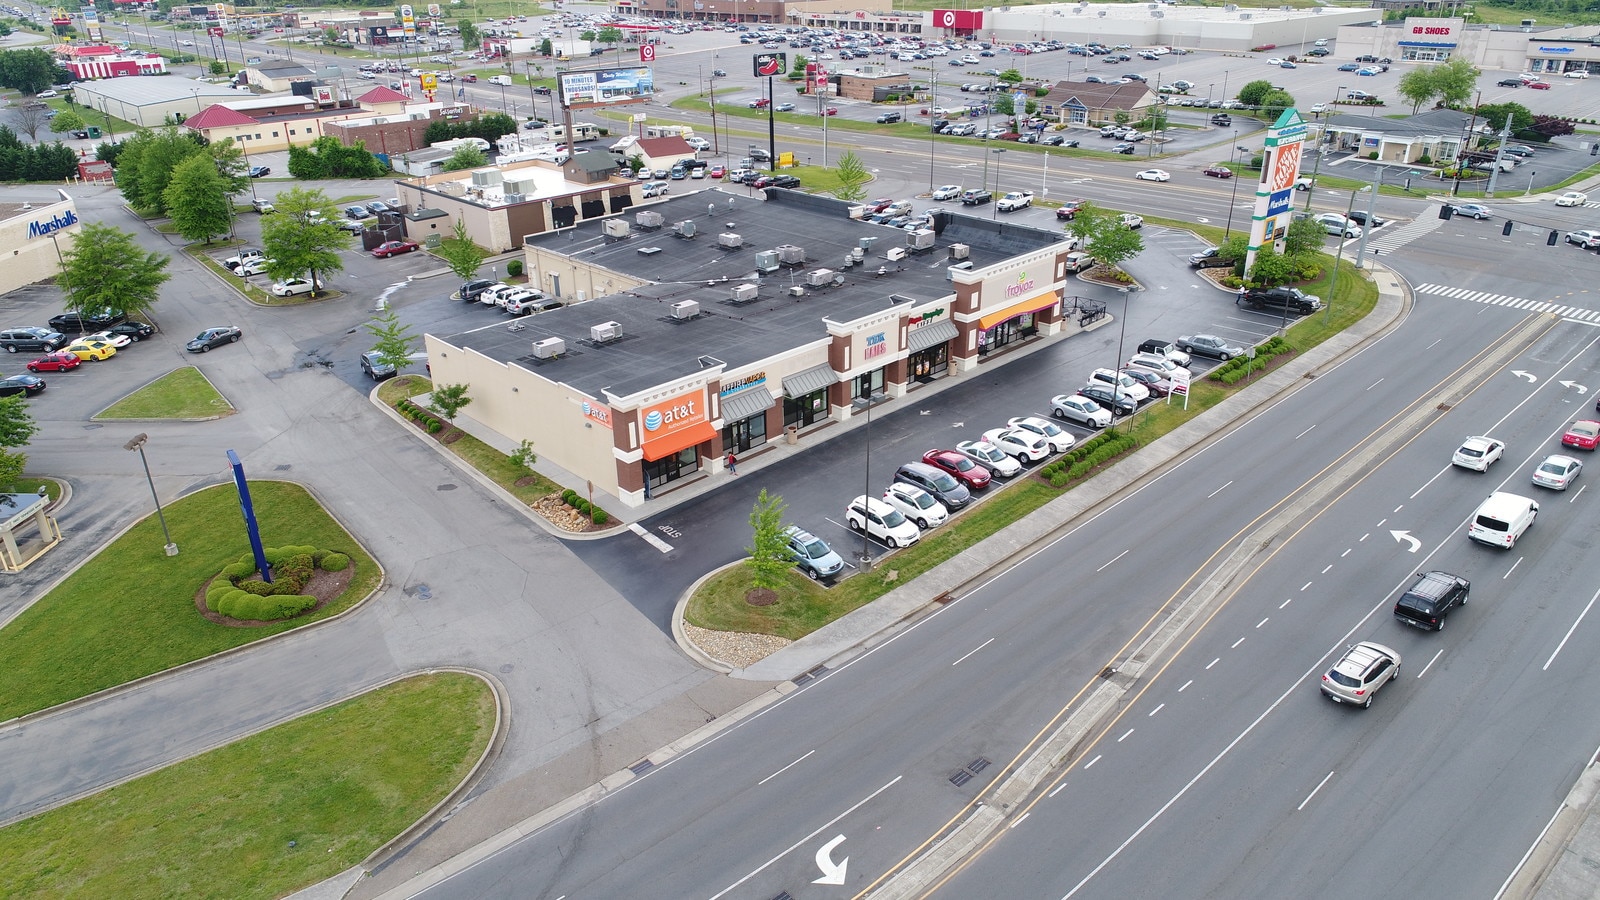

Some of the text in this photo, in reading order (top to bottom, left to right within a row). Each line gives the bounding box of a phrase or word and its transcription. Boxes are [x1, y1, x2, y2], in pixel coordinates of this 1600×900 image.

[1412, 26, 1450, 35] GB SHOES
[571, 76, 593, 84] MINUTES
[1273, 144, 1299, 190] HOME
[27, 209, 79, 239] Marshalls
[1006, 280, 1034, 297] froyoz
[590, 407, 609, 423] at&t
[664, 400, 695, 424] at&t
[657, 525, 682, 538] STOP
